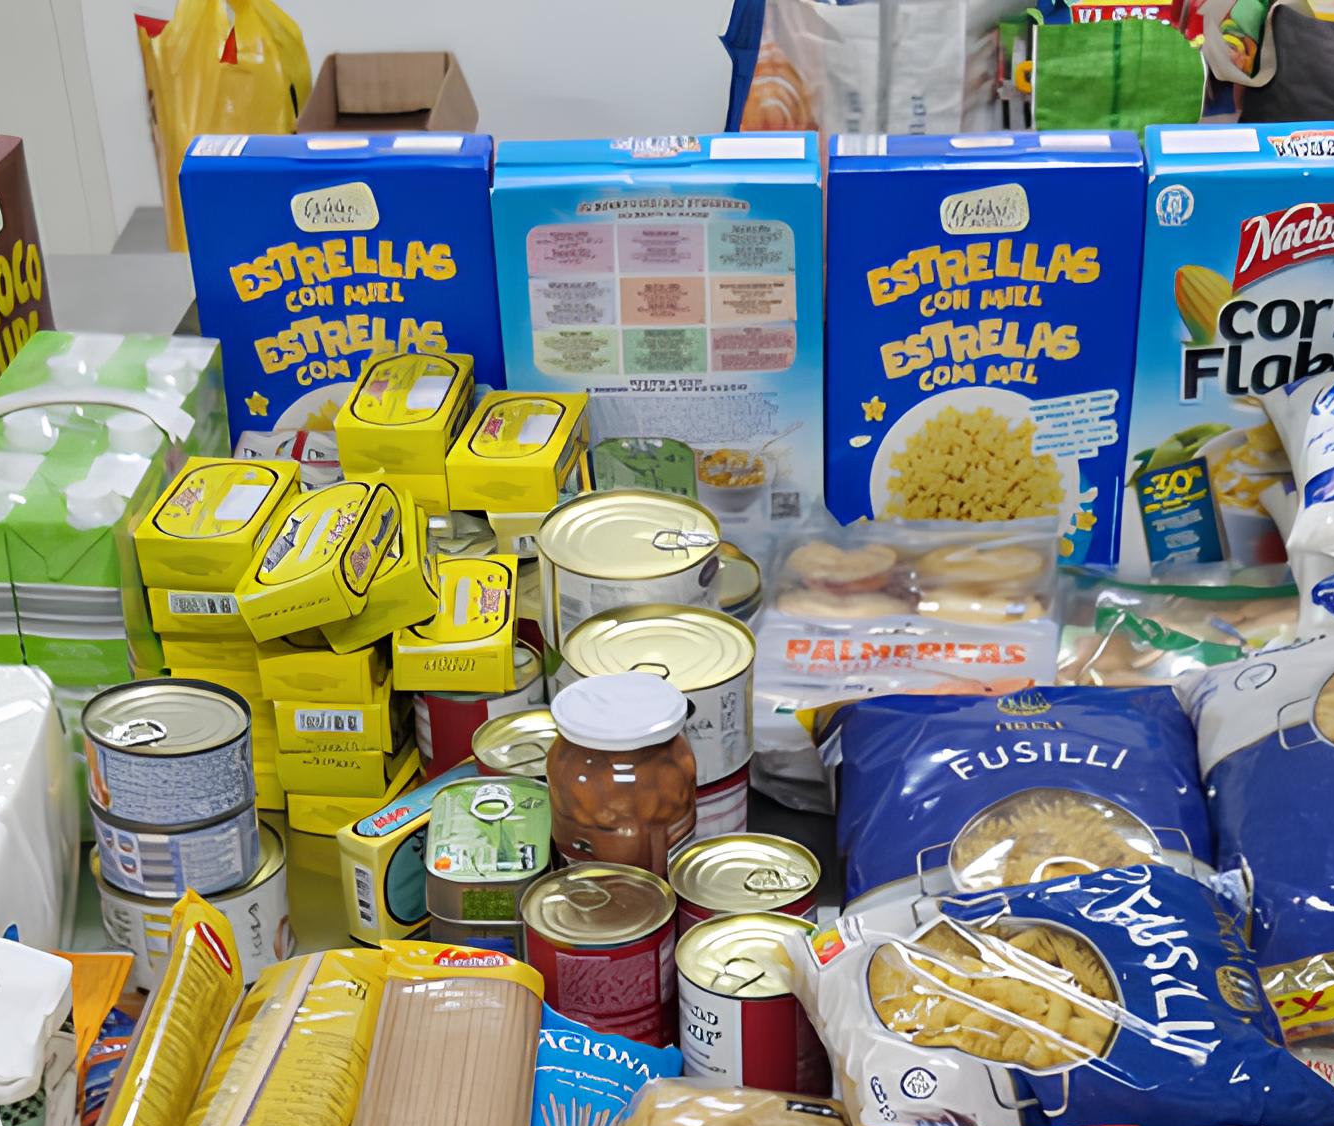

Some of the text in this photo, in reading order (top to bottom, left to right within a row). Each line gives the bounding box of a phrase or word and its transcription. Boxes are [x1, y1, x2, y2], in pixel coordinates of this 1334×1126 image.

[229, 236, 458, 303] ESTRELLAS
[867, 238, 1101, 307] ESTRELLAS
[285, 287, 334, 313] CON
[919, 289, 970, 317] CON
[880, 318, 1081, 380] ESTRELAS
[948, 740, 1129, 781] FUSILLI
